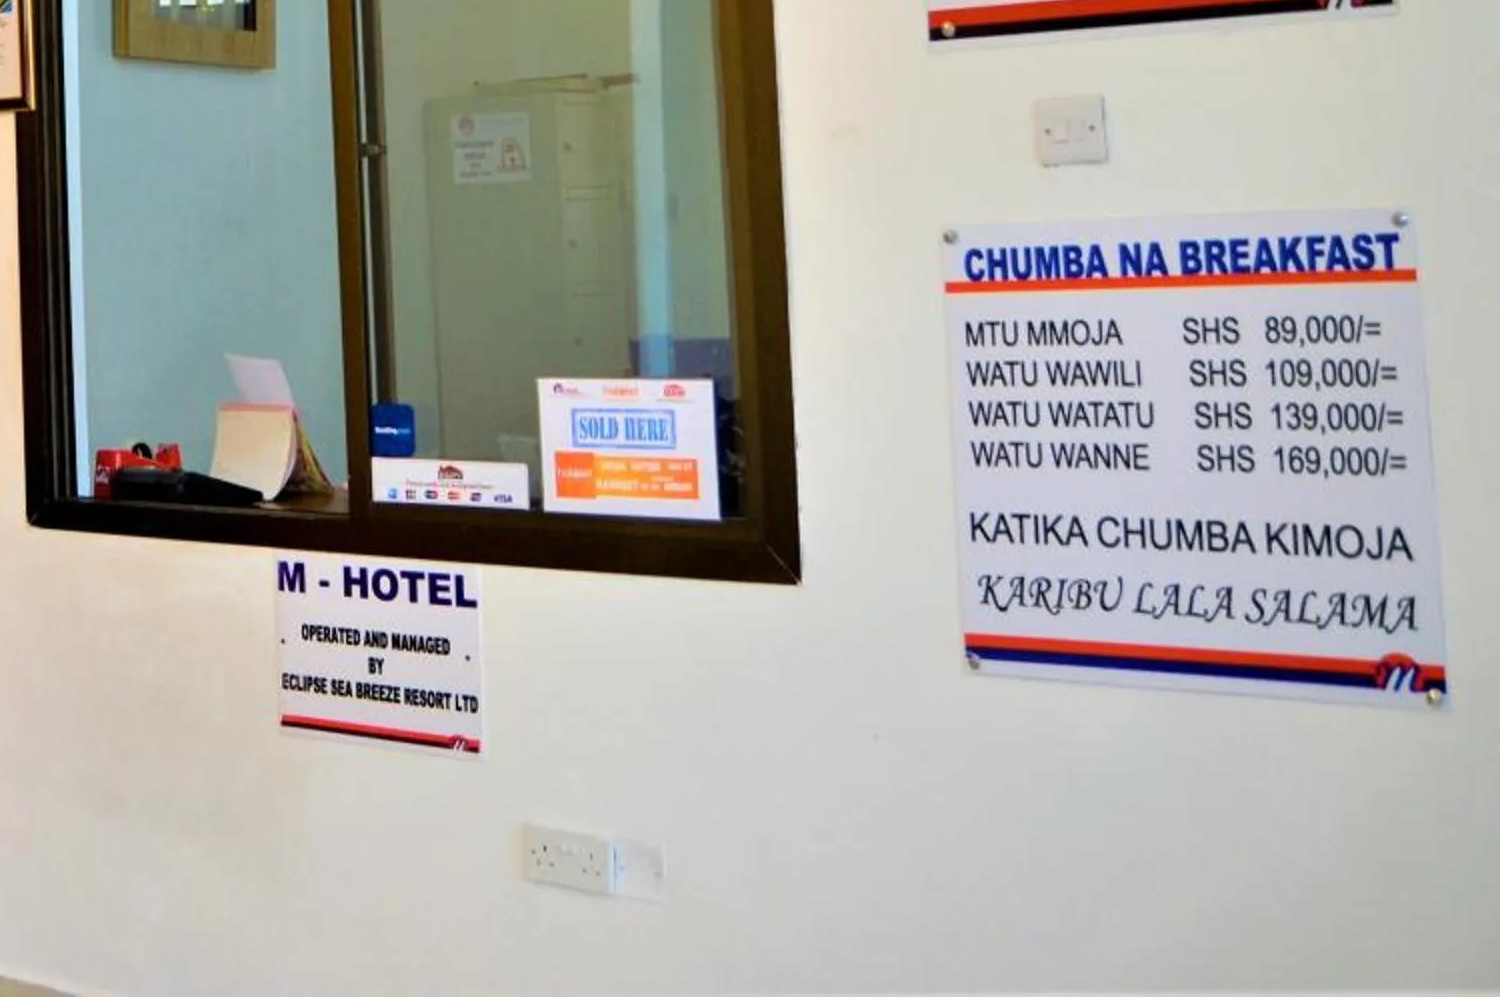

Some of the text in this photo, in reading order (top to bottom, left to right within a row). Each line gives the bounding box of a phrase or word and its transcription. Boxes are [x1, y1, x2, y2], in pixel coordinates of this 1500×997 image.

[964, 232, 1400, 282] CHUMBA NA BREAKFAST
[965, 315, 1382, 348] MTU MMOJA SHS 89,000/=
[966, 359, 1398, 391] WATU WAWILI SHS 109,000/=
[579, 416, 669, 442] SOLD HERE
[968, 401, 1404, 435] WATU WATATU SHS 139,000/=
[970, 441, 1407, 479] WATU WANNE SHS 169,000/=
[969, 512, 1414, 562] KATIKA CHUMBA KIMOJA
[277, 561, 306, 593] M
[343, 566, 478, 609] HOTEL
[978, 574, 1419, 634] KARIBU LALA SALAMA
[301, 623, 451, 655] OPERATED AND MANAGED
[368, 657, 385, 675] BY
[282, 673, 479, 714] ECLIPSE SEA BREEZE RESORT LTD
